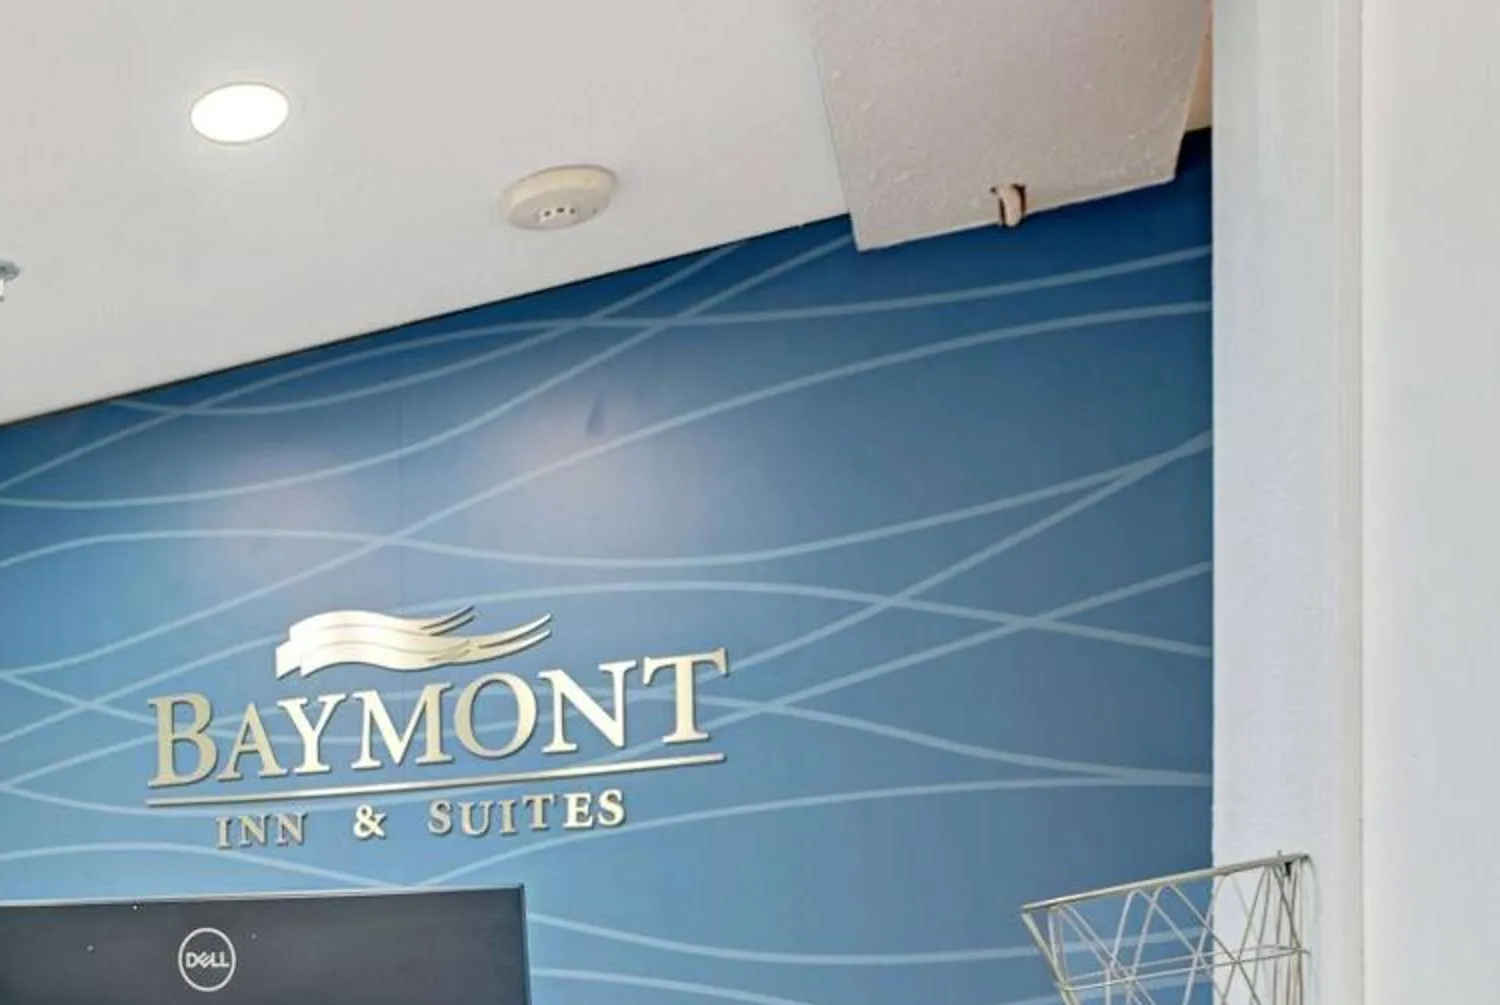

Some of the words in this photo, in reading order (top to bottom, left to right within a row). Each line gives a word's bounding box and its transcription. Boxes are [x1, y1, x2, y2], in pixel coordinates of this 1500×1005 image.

[146, 647, 729, 788] BAYMONT
[216, 810, 307, 849] INN
[353, 805, 385, 839] &
[427, 788, 627, 838] SUITES
[186, 951, 230, 969] DELL
